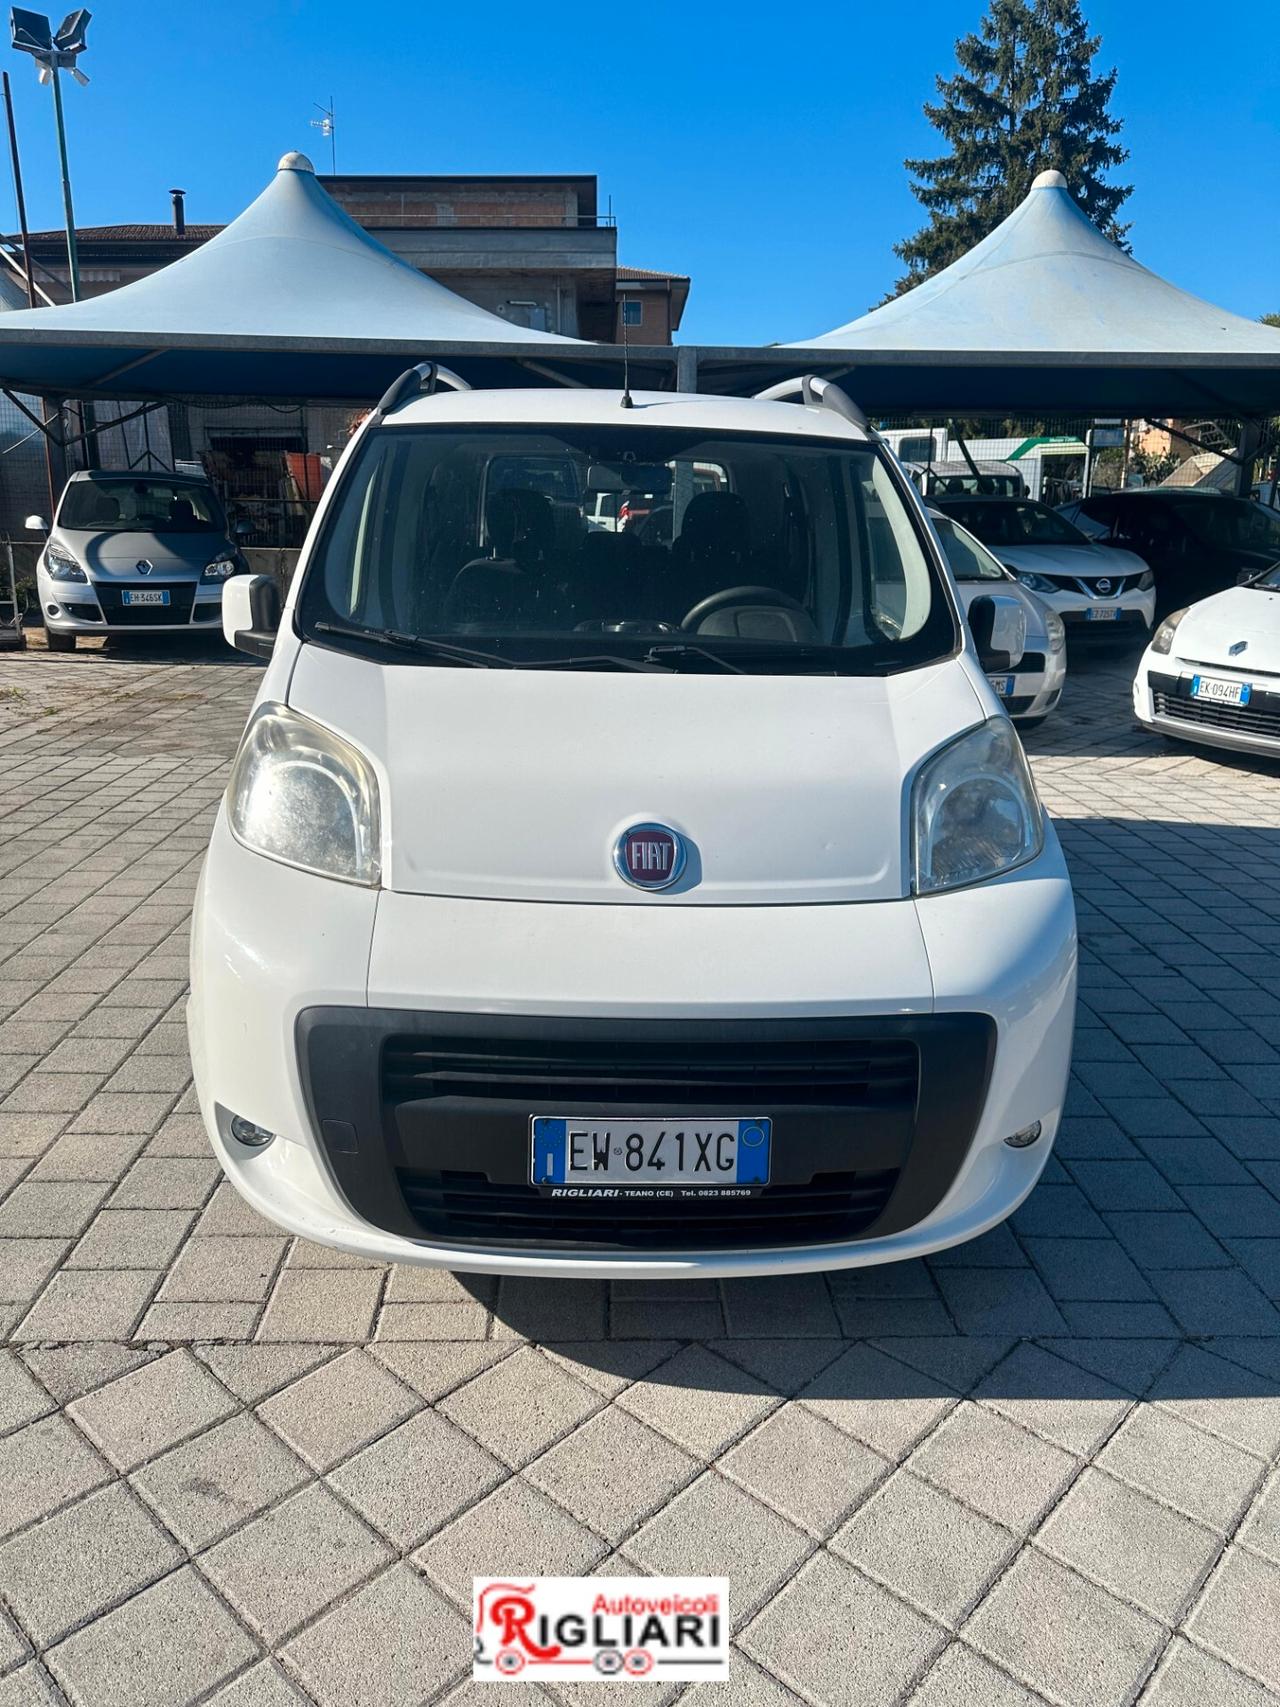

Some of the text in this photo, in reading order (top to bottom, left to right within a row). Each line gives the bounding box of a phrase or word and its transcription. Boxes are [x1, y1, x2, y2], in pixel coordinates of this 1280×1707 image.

[1200, 680, 1240, 699] EK 094HF
[631, 841, 672, 870] FIAT
[568, 1131, 611, 1171] EW
[625, 1131, 735, 1172] 841XG
[656, 1190, 674, 1198] (CE)
